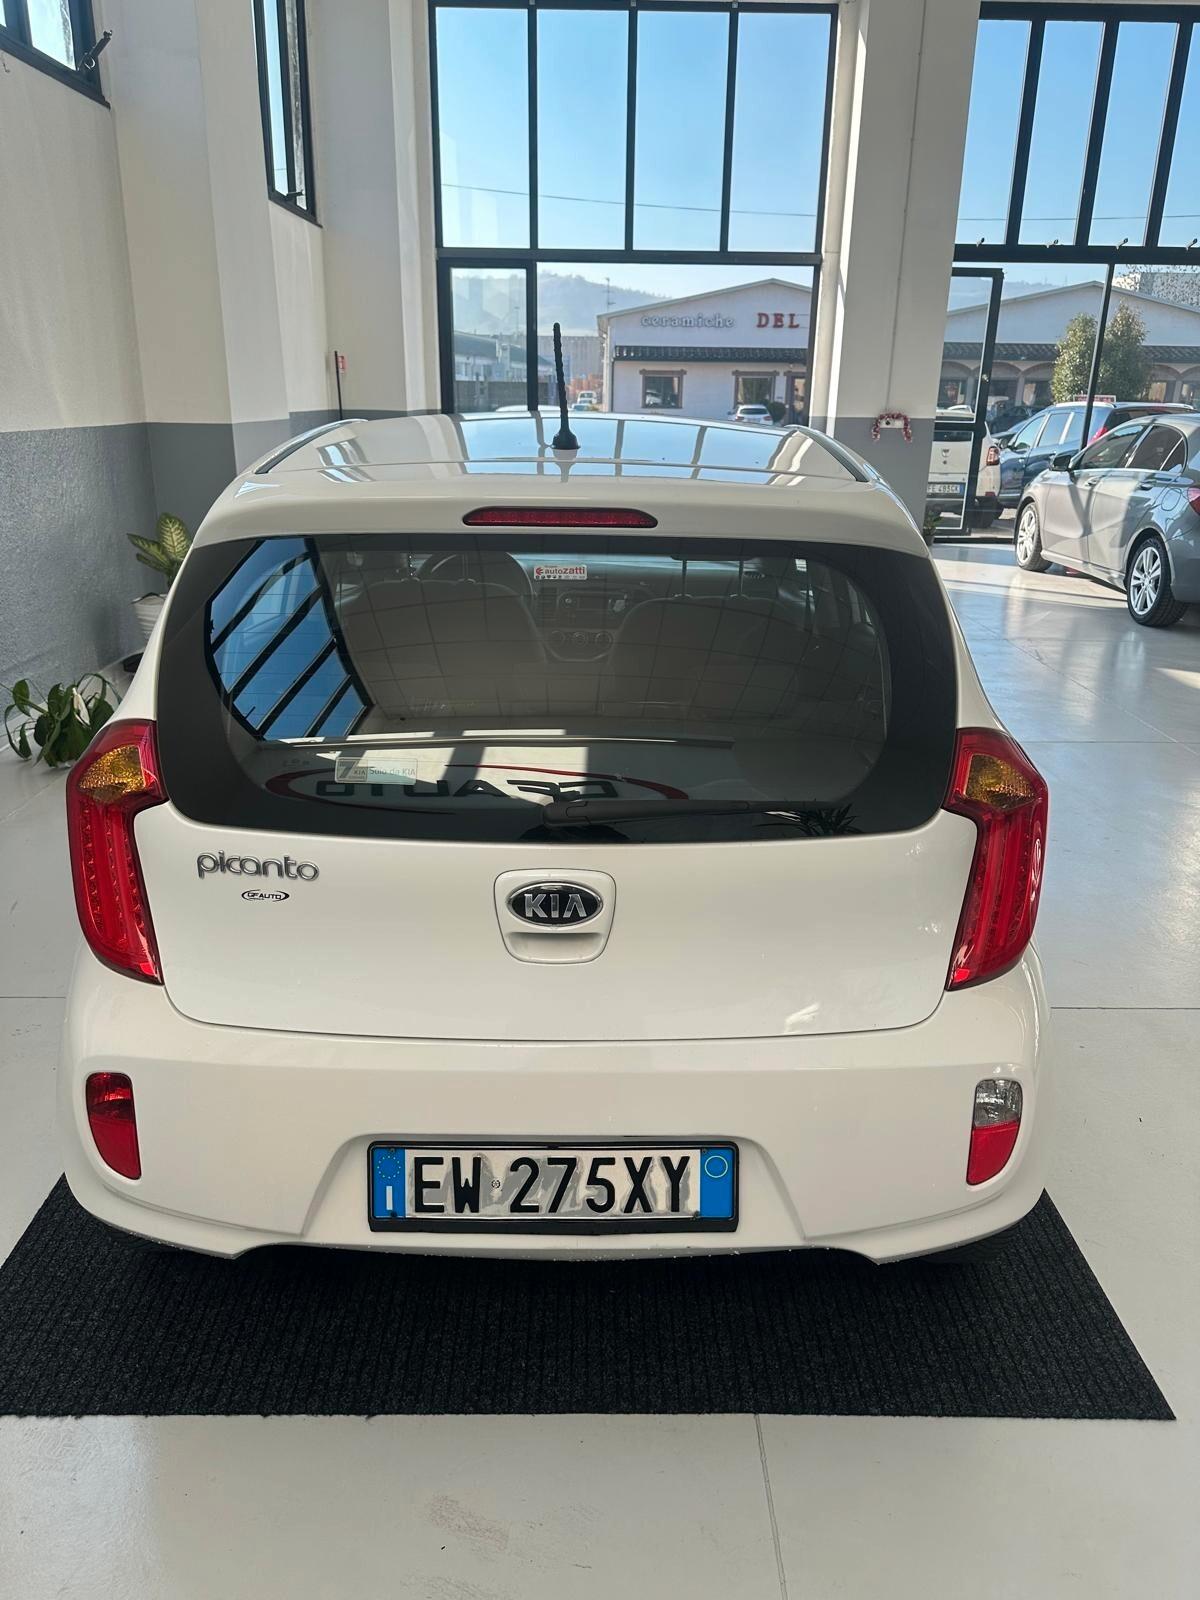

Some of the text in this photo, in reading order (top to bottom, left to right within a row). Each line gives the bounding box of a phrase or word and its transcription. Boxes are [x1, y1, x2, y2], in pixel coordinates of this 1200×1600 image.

[641, 312, 800, 329] ceramiche DEL
[544, 566, 585, 575] autozatti
[197, 850, 319, 881] picanto
[524, 893, 587, 918] KIA
